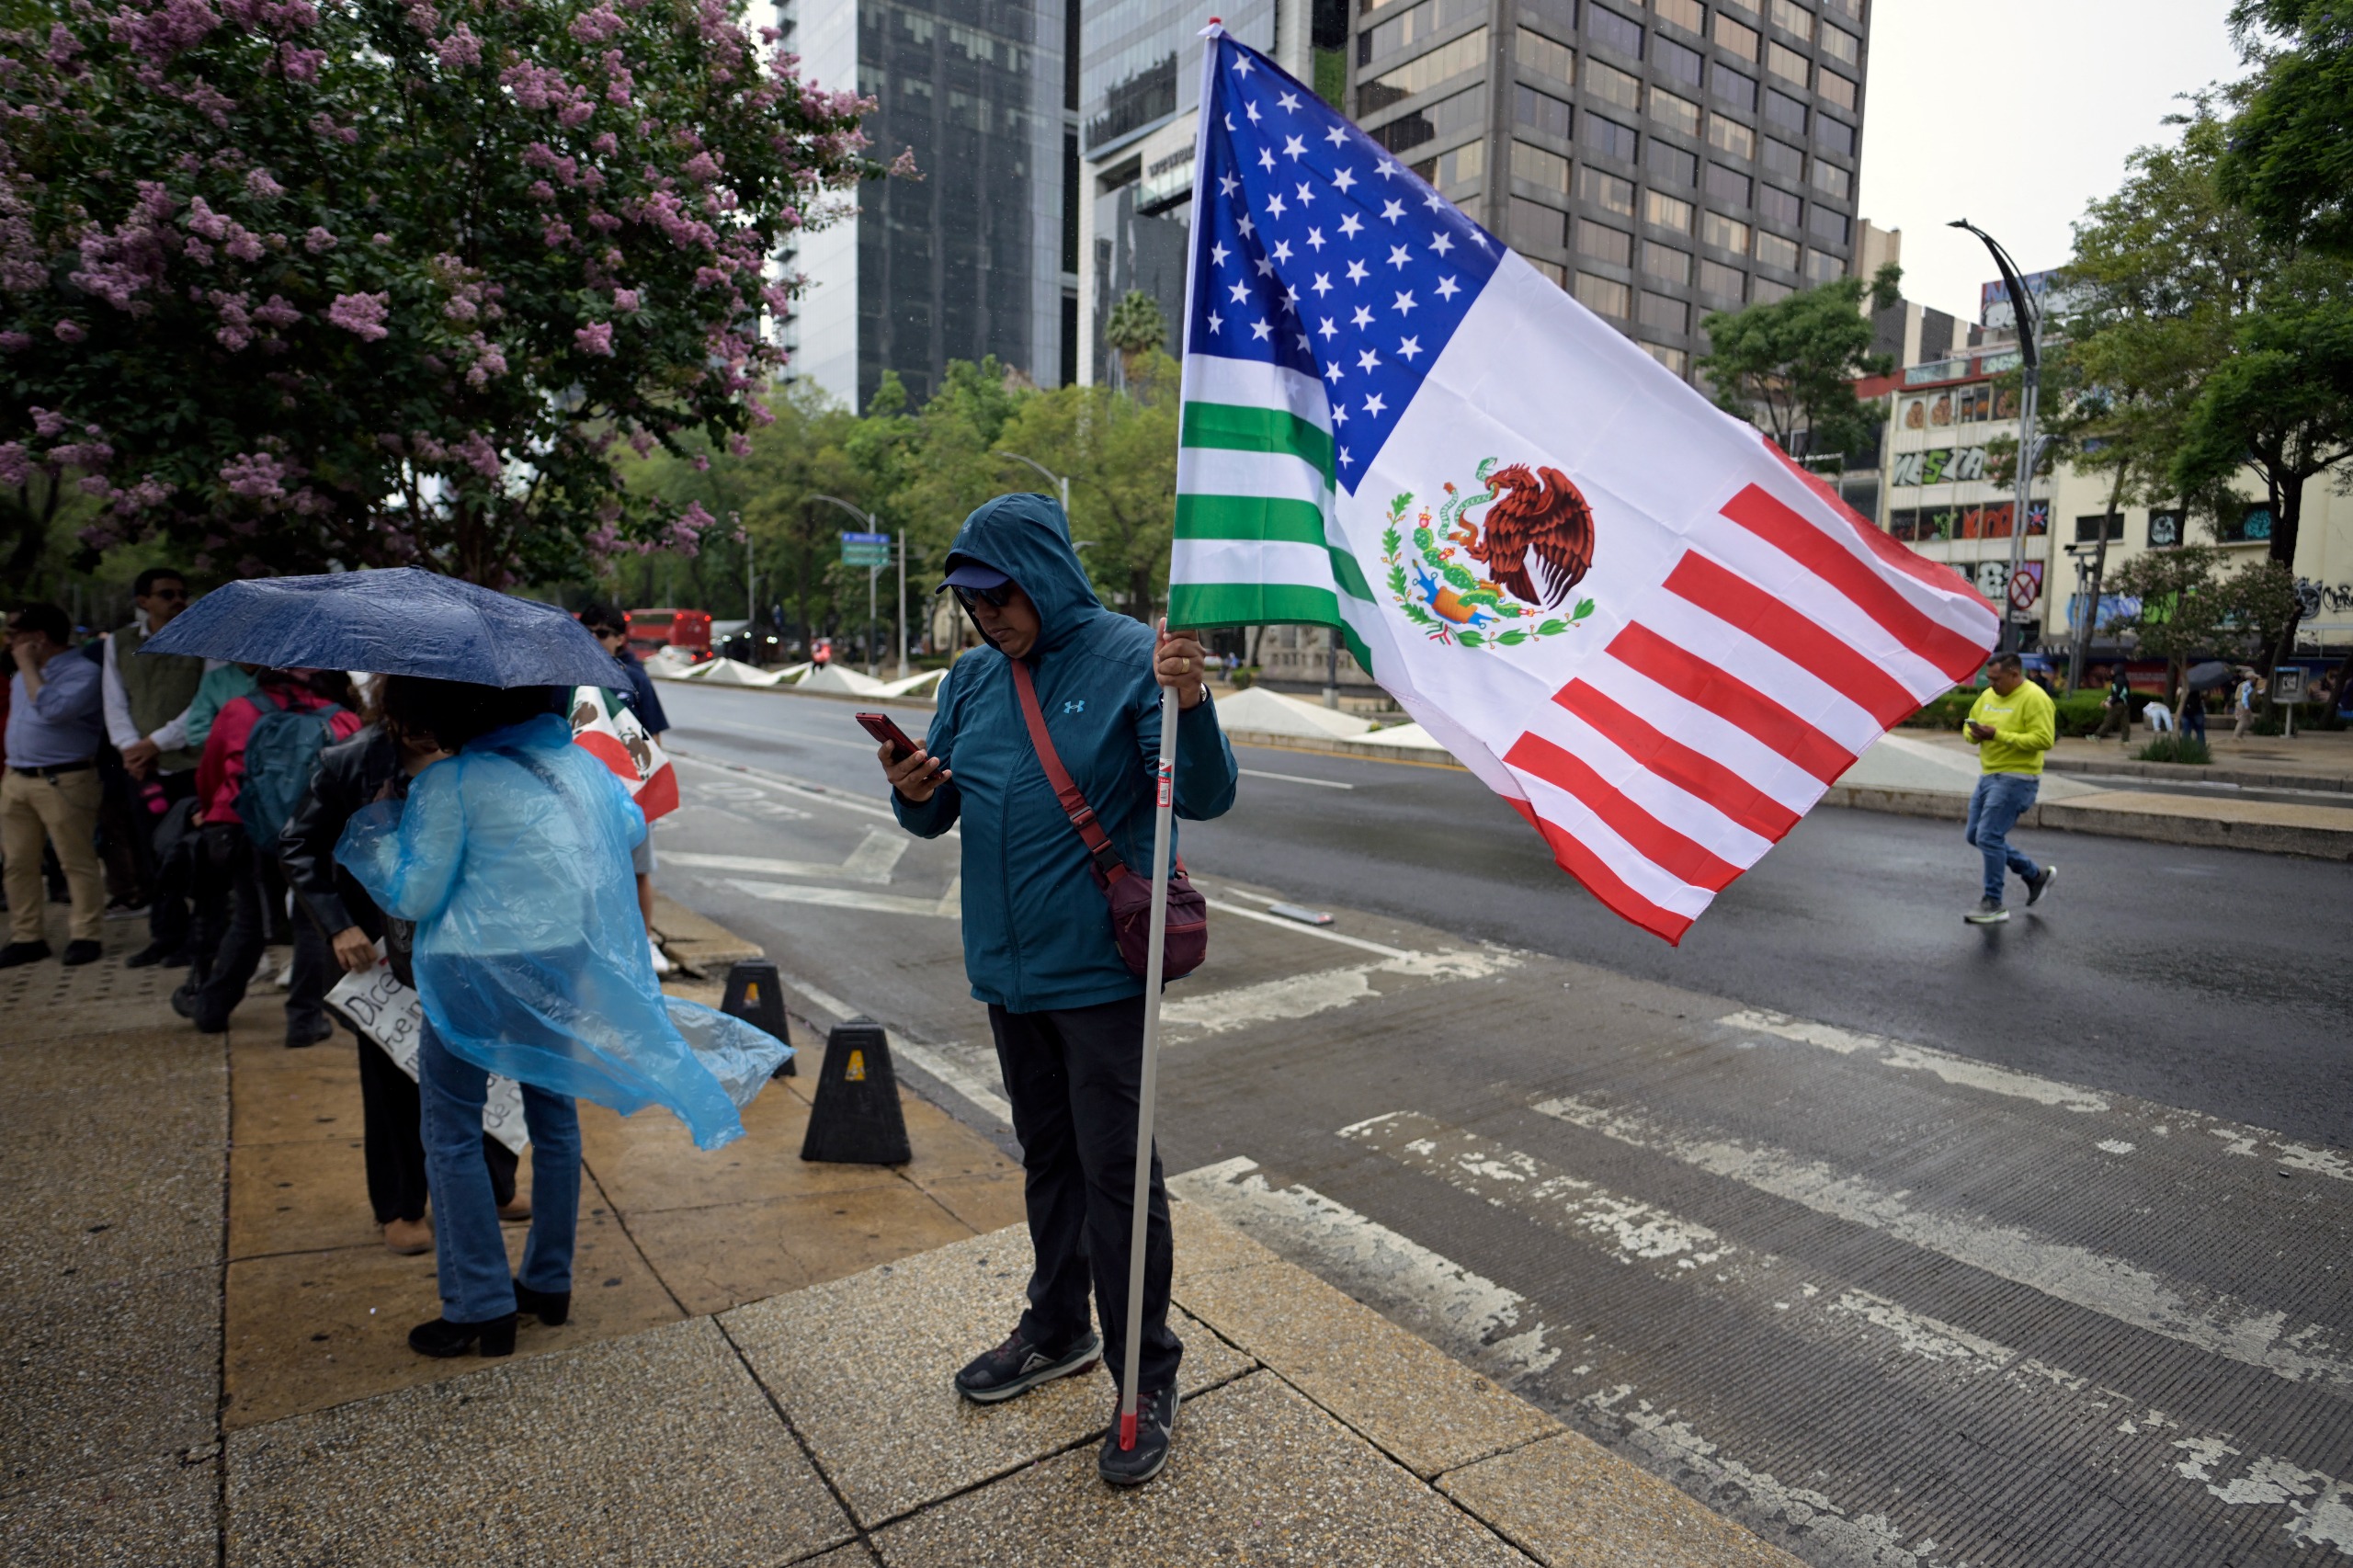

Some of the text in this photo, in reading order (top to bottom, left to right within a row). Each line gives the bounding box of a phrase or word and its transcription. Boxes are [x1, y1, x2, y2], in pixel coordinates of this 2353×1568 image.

[344, 971, 403, 1027] Dice
[375, 1017, 412, 1052] fue
[483, 1104, 511, 1129] de
